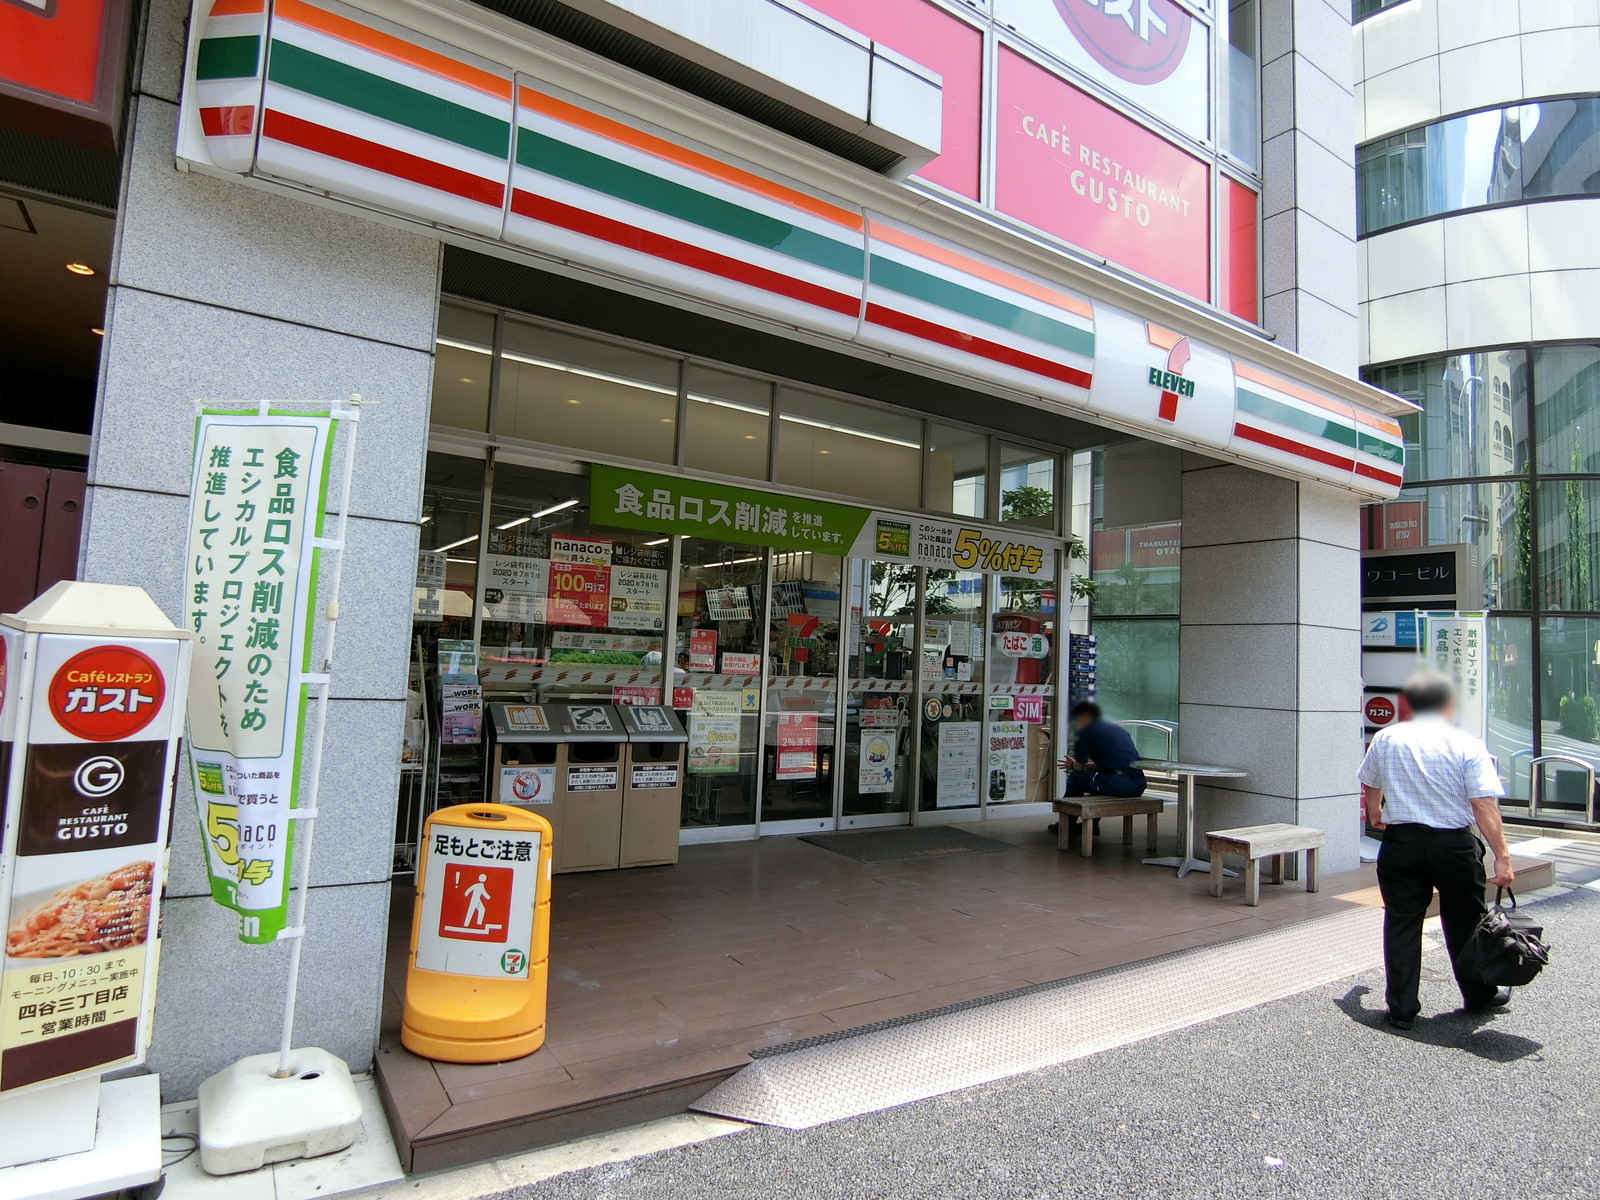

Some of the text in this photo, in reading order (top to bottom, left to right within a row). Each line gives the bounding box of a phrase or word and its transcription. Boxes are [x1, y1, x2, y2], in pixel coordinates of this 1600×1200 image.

[1021, 117, 1190, 217] CAFÉ RESTAURANT
[1070, 170, 1151, 227] GUSTO
[614, 483, 788, 536] 食品ロス削減
[792, 511, 823, 527] を推進
[791, 527, 845, 545] しています。
[918, 524, 953, 536] このシールが
[192, 446, 232, 645] 推進しています。
[918, 534, 952, 544] ついた商品は
[917, 543, 952, 559] nanaco
[952, 528, 1043, 574] 5%付与
[495, 559, 540, 571] レジ袋有料化
[615, 555, 665, 567] ご協力ください
[620, 571, 659, 581] レジ袋有料化
[1366, 564, 1450, 583] ワコービル
[240, 447, 301, 732] 食品ロス削減のため
[502, 577, 530, 587] スタート
[626, 588, 650, 596] スタート
[1003, 634, 1042, 652] たばこ 酒
[67, 669, 153, 683] Caféレストラン
[64, 687, 153, 714] ガスト
[1017, 702, 1040, 718] SIM
[1368, 708, 1393, 718] ガスト
[782, 737, 813, 747] 2%還元
[238, 793, 279, 805] で買うと
[82, 804, 110, 816] CAFÉ
[59, 812, 129, 826] RESTAURANT
[57, 823, 129, 841] GUSTO
[434, 834, 532, 862] 足もとご注意
[99, 926, 120, 935] Light
[11, 968, 139, 999] モーニングメニュー実施中
[18, 985, 129, 1021] 四谷三丁目店
[41, 1009, 107, 1036] 営業時間
